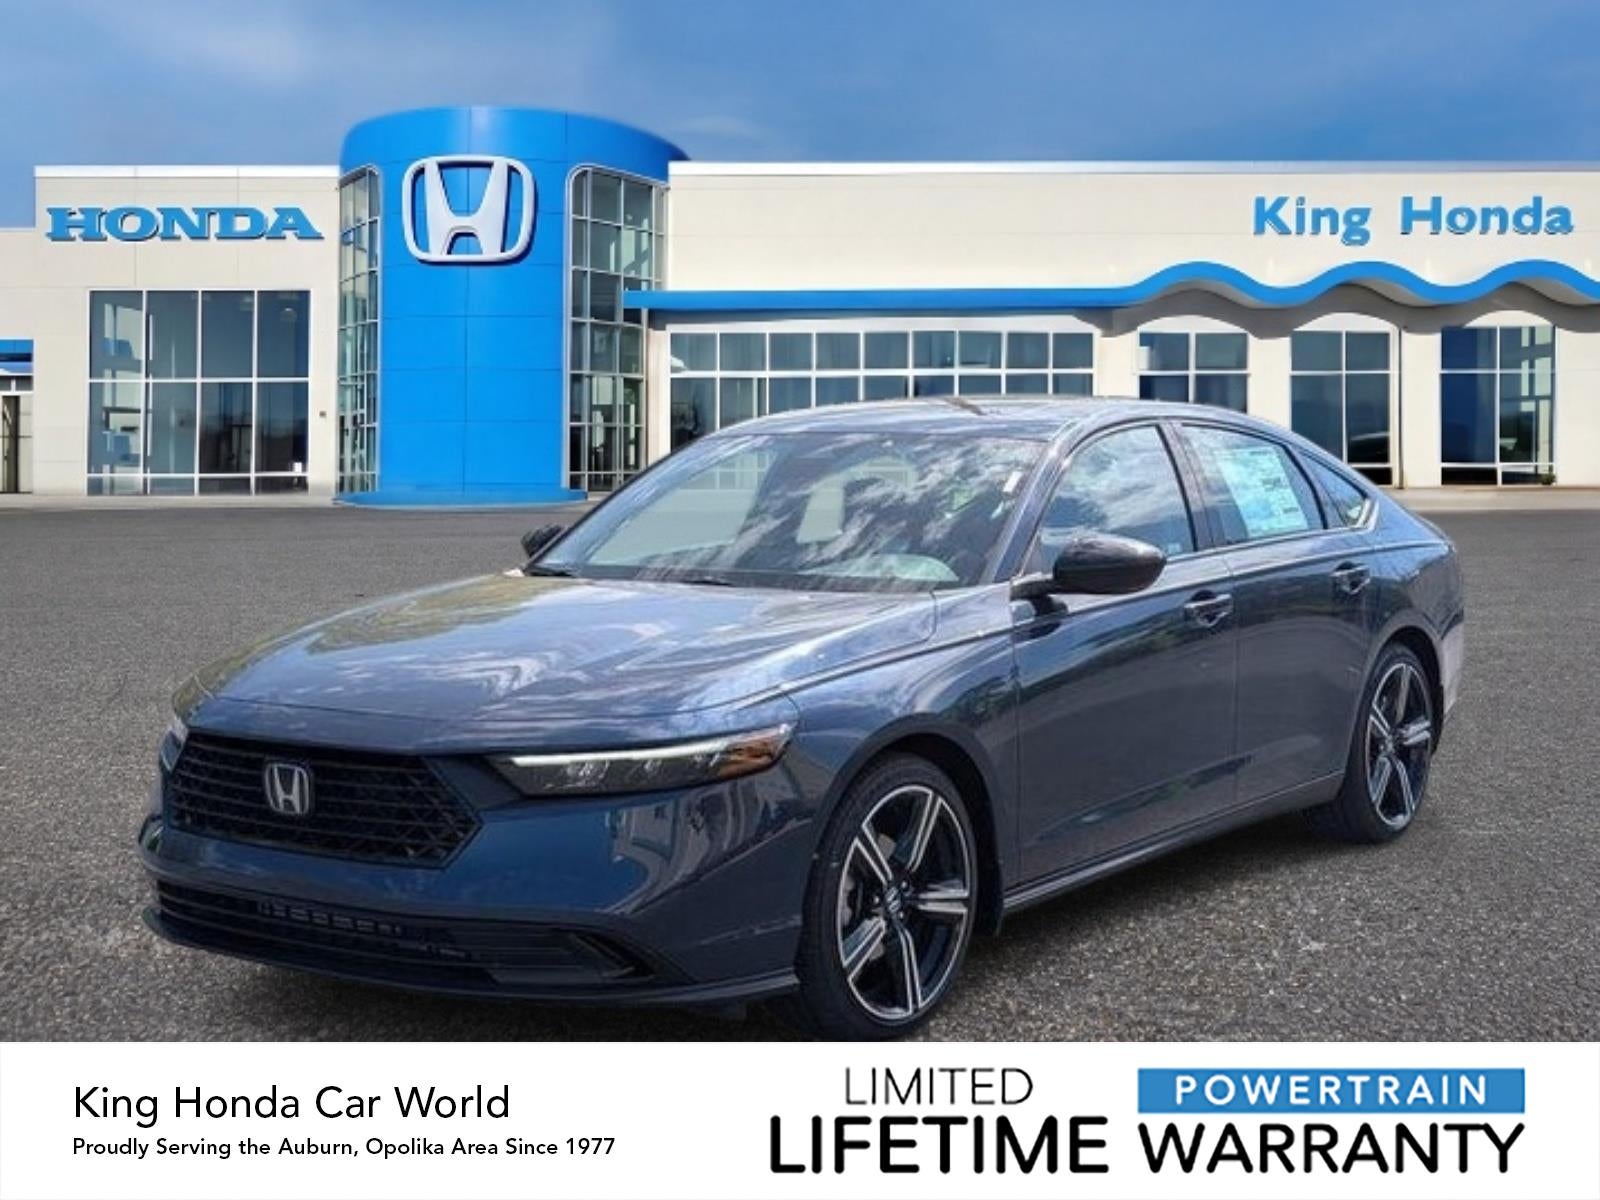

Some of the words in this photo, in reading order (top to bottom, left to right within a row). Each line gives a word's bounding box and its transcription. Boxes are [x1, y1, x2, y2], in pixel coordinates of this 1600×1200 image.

[46, 205, 323, 242] HONDA
[1252, 195, 1372, 247] King
[1400, 195, 1575, 237] Honda
